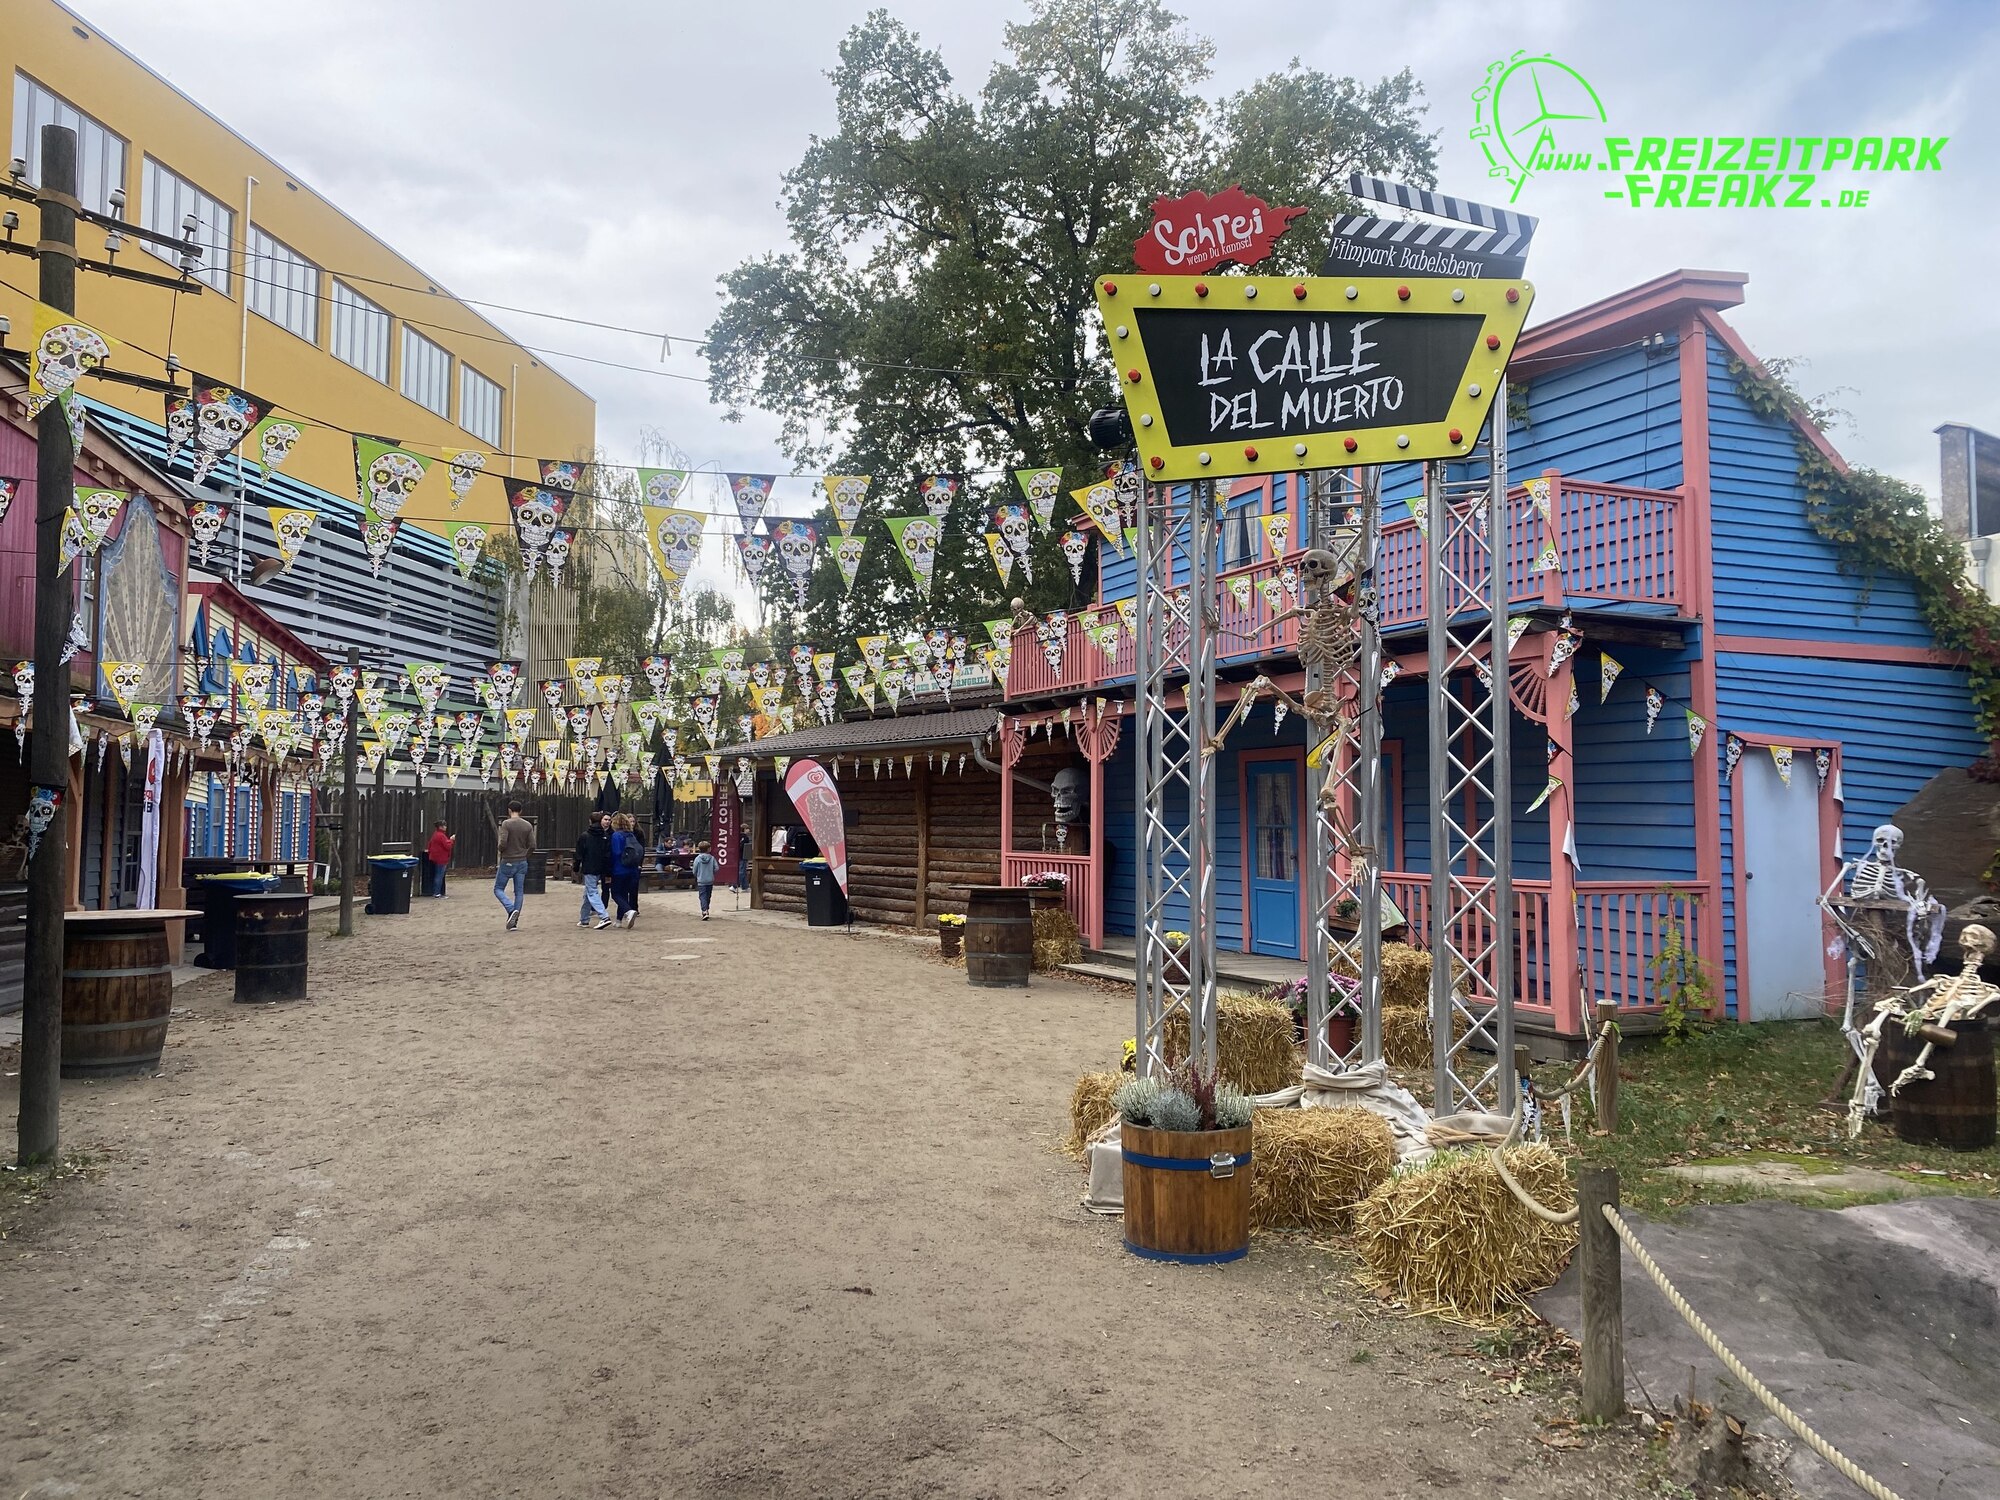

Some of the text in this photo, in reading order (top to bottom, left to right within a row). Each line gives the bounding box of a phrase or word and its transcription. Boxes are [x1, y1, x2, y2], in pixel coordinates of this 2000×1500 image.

[1154, 207, 1264, 266] Schrei
[1186, 235, 1253, 267] wenn Du kannst!
[1328, 236, 1484, 280] Filmpark Babelsberg
[1198, 317, 1385, 387] LA CALLE
[1209, 375, 1404, 432] DEL MUERTO
